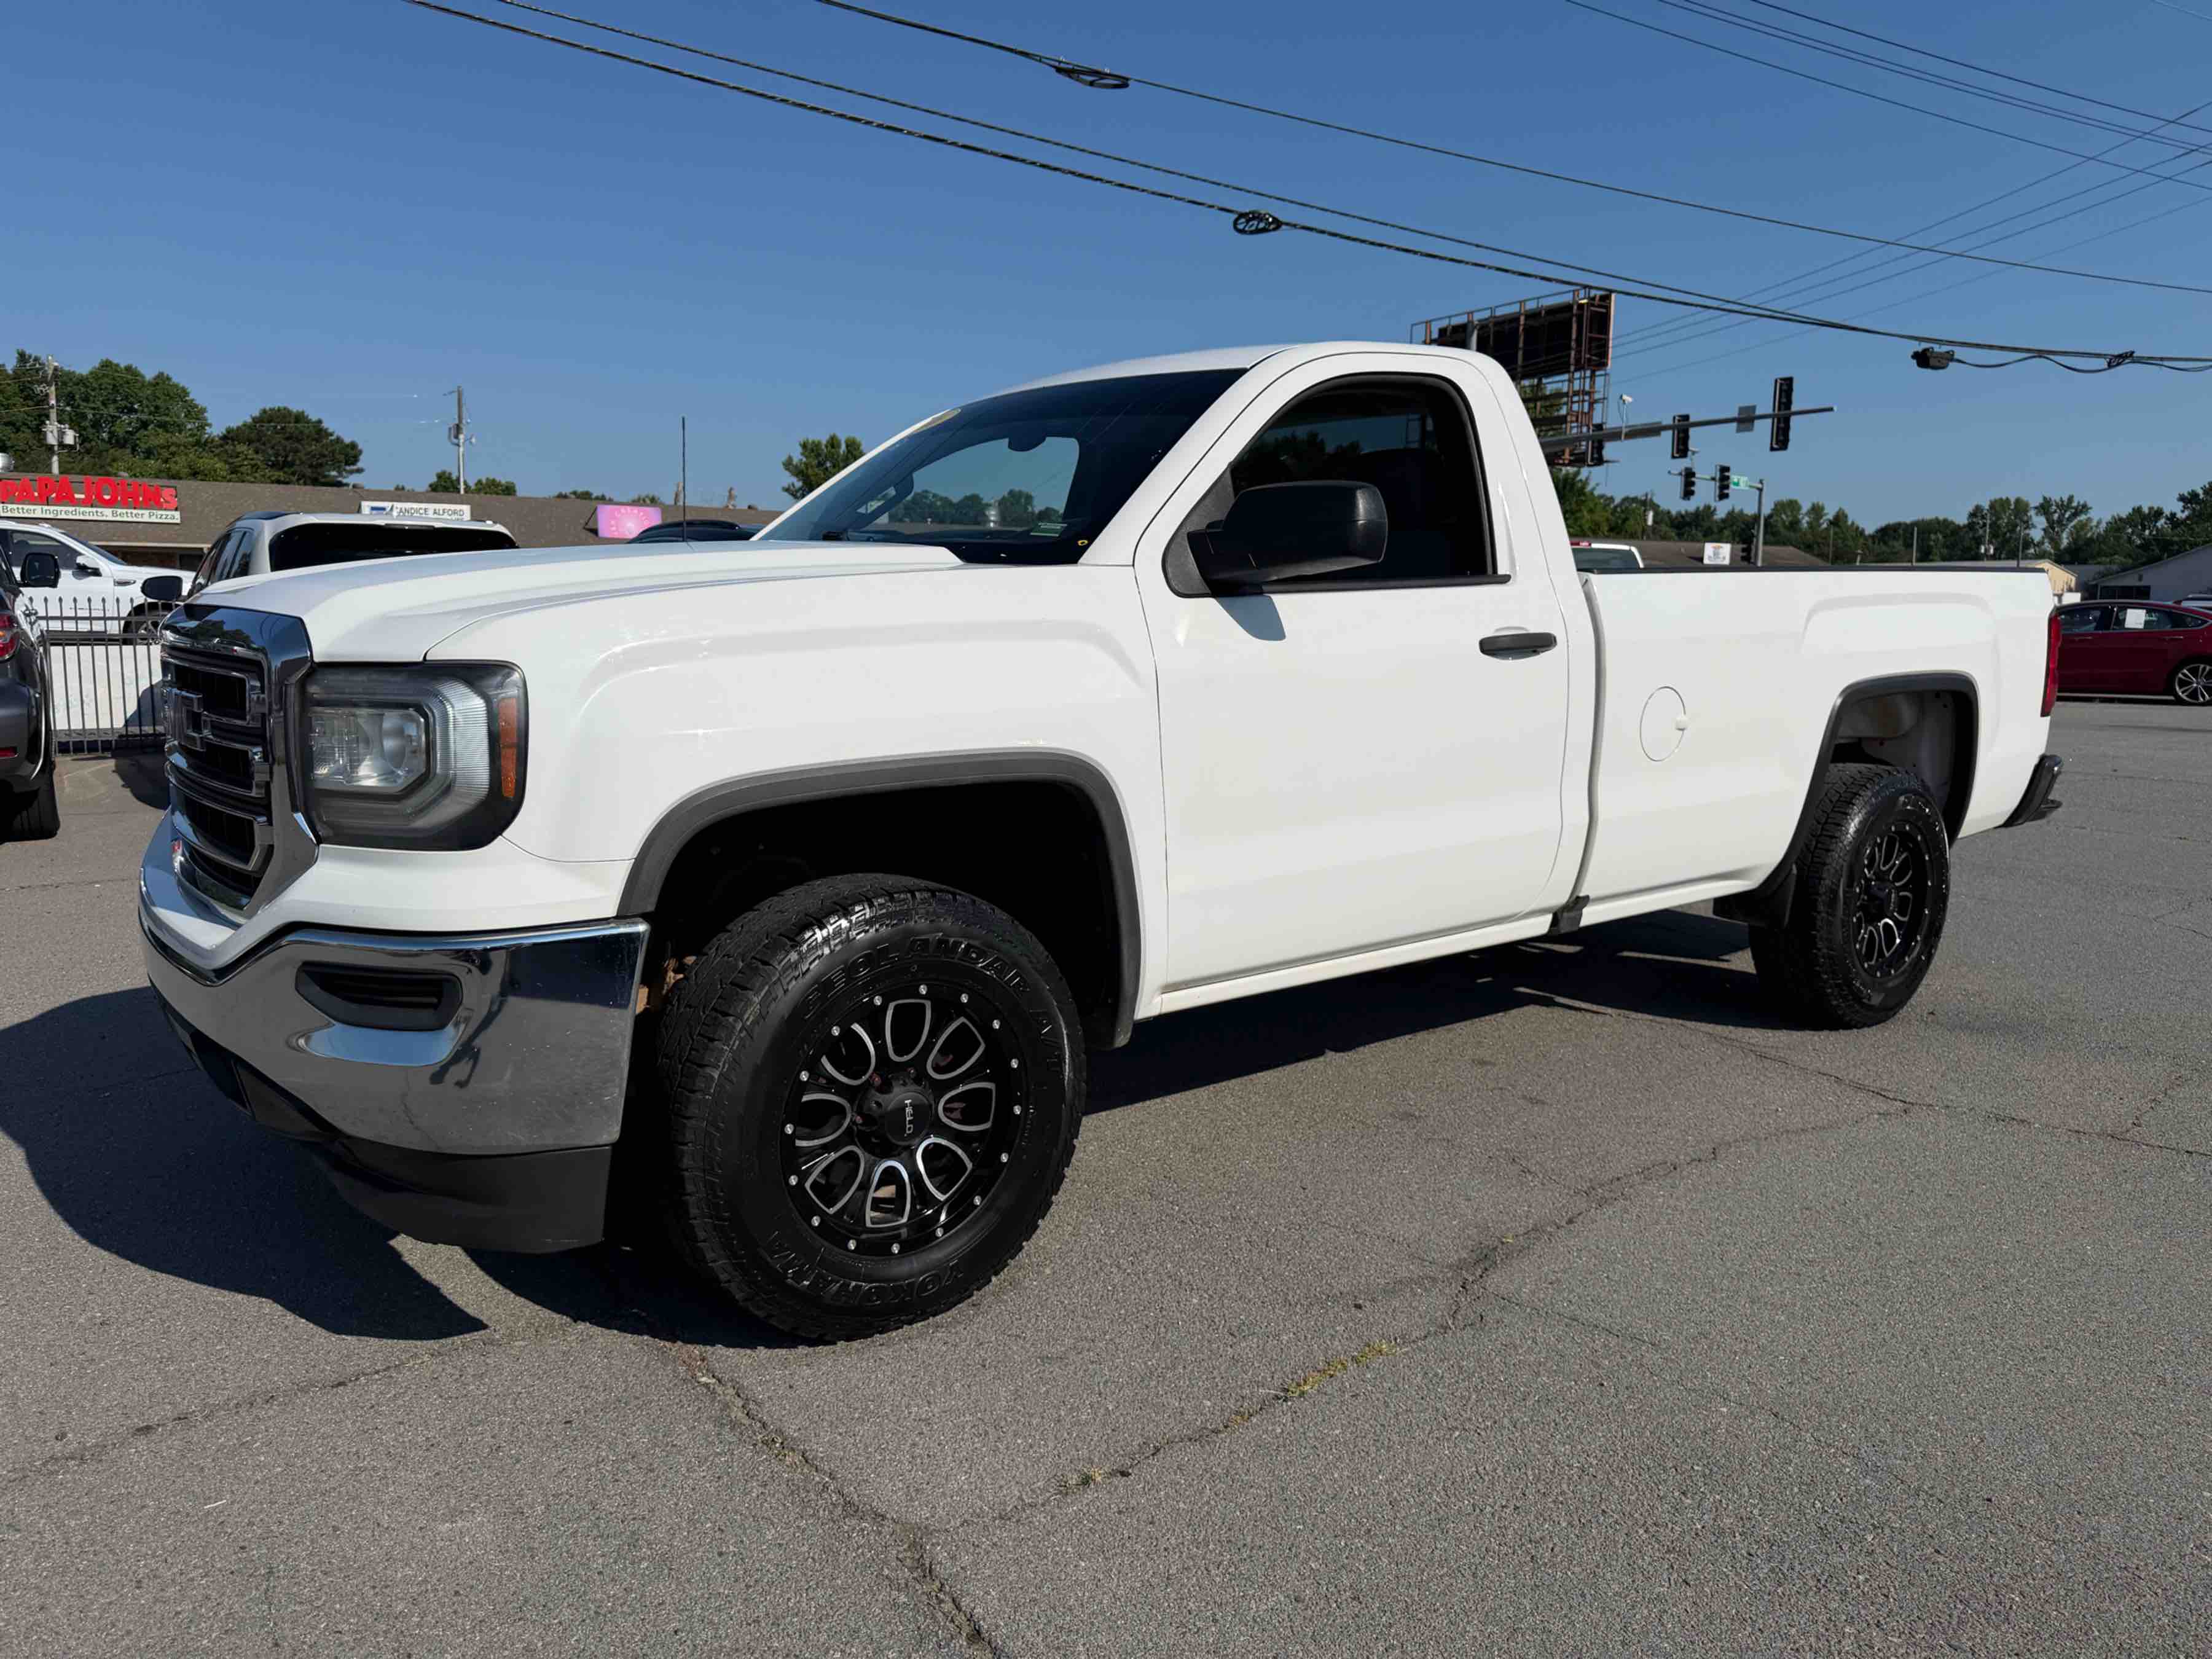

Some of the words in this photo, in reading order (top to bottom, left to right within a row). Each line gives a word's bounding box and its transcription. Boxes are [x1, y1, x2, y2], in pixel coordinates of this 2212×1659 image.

[0, 476, 77, 503] PAPA
[80, 476, 178, 510] JOHNS
[1, 504, 36, 514] Better
[41, 506, 109, 519] Ingredients.
[112, 510, 145, 520] Better
[148, 512, 179, 521] Pizza.
[432, 507, 465, 517] ALFORD
